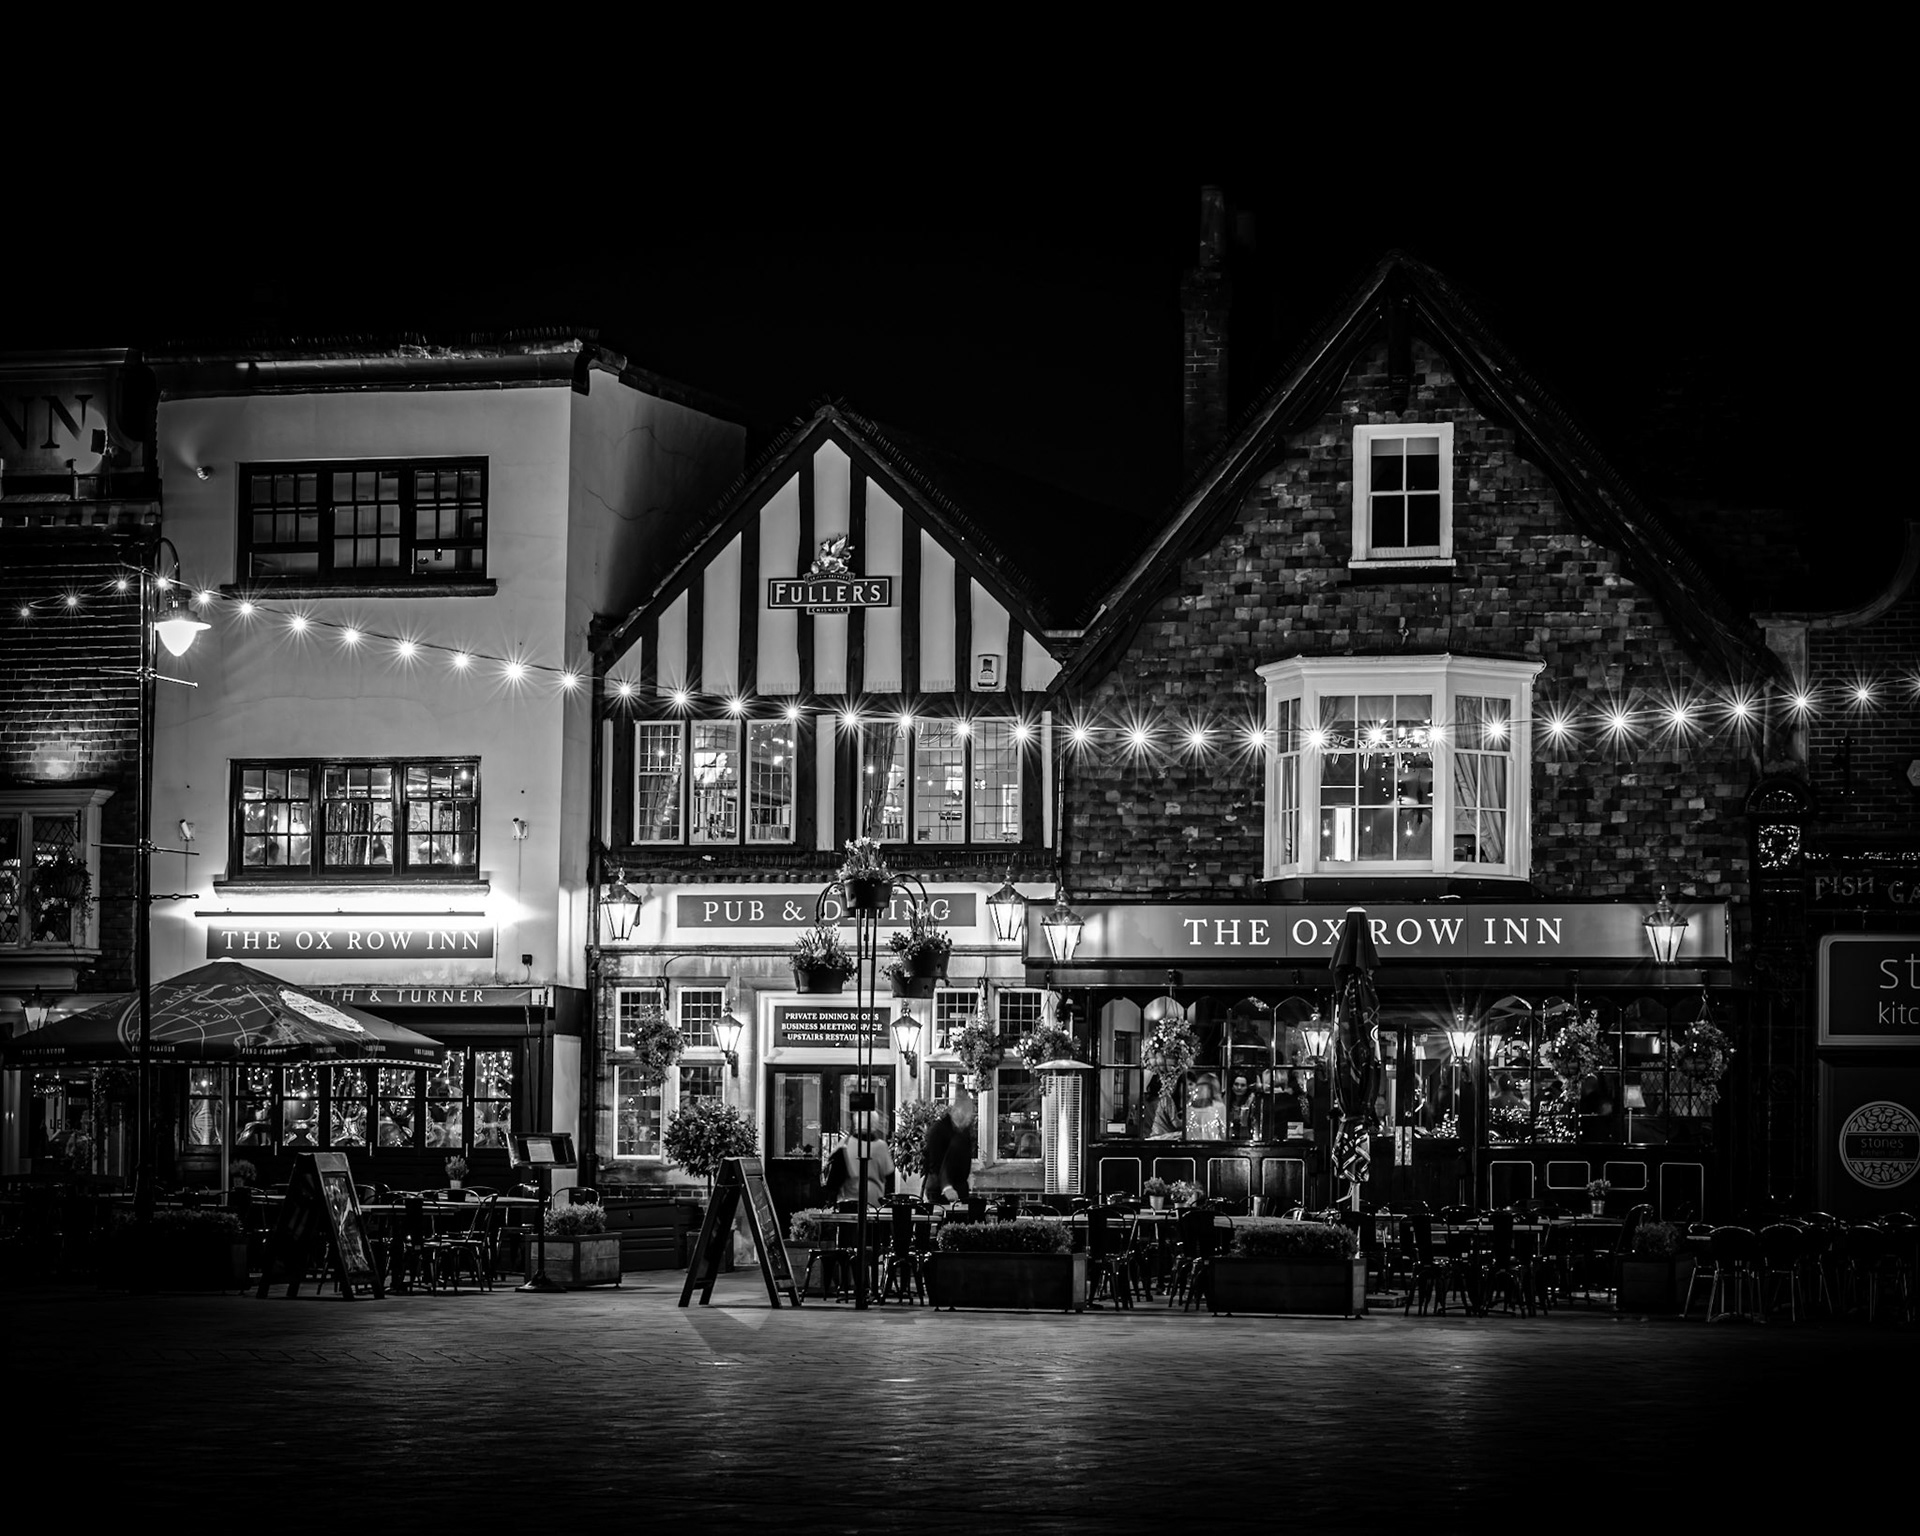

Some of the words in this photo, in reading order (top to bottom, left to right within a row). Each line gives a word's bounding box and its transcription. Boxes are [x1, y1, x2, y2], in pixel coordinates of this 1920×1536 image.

[775, 582, 881, 603] FULLER'S
[1815, 876, 1875, 900] FISH
[703, 900, 765, 922] PUB
[782, 900, 806, 921] &
[823, 899, 951, 921] DING
[221, 931, 281, 950] THE
[295, 931, 333, 950] OX
[347, 931, 413, 950] ROW
[426, 931, 480, 950] INN
[1183, 918, 1271, 946] THE
[1292, 918, 1346, 946] OX
[1368, 918, 1464, 946] ROW
[1484, 918, 1562, 946] INN
[369, 989, 382, 1002] &
[397, 990, 484, 1003] TURNER
[781, 1023, 818, 1031] BUSINESS
[819, 1023, 857, 1031] MEETING
[787, 1033, 824, 1041] UPSTAIRS
[1860, 1137, 1904, 1149] stones
